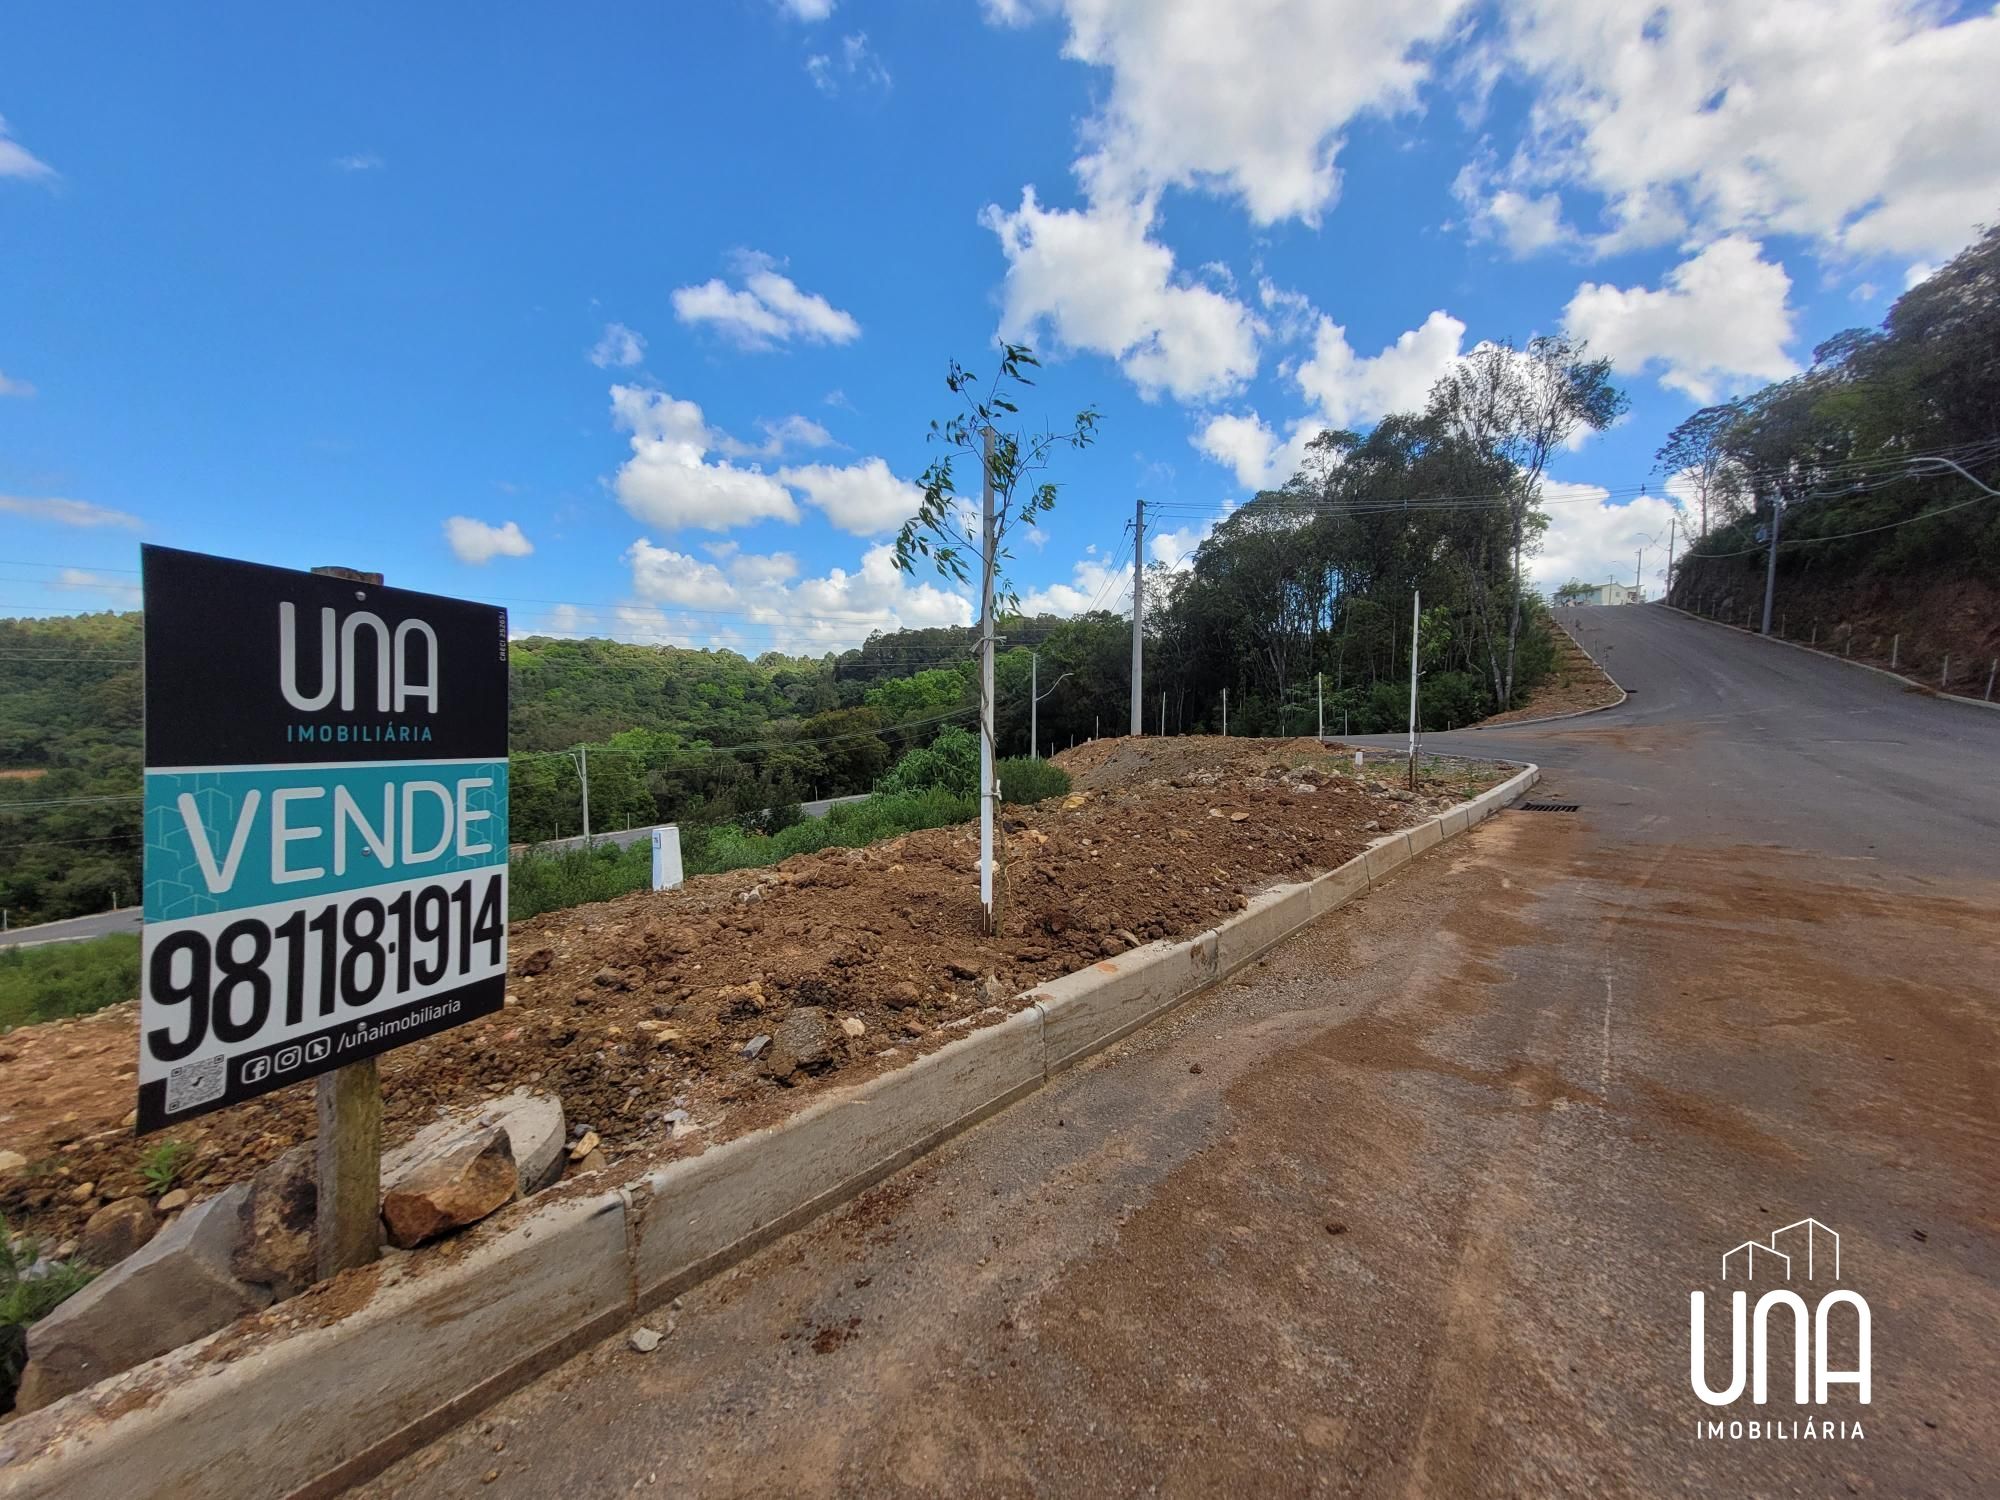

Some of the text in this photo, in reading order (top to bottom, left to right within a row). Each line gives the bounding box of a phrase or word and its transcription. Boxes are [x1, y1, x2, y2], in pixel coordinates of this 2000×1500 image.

[280, 601, 438, 714] UNA
[287, 721, 433, 742] IMOBILIÁRIA
[177, 778, 494, 894] VENDE
